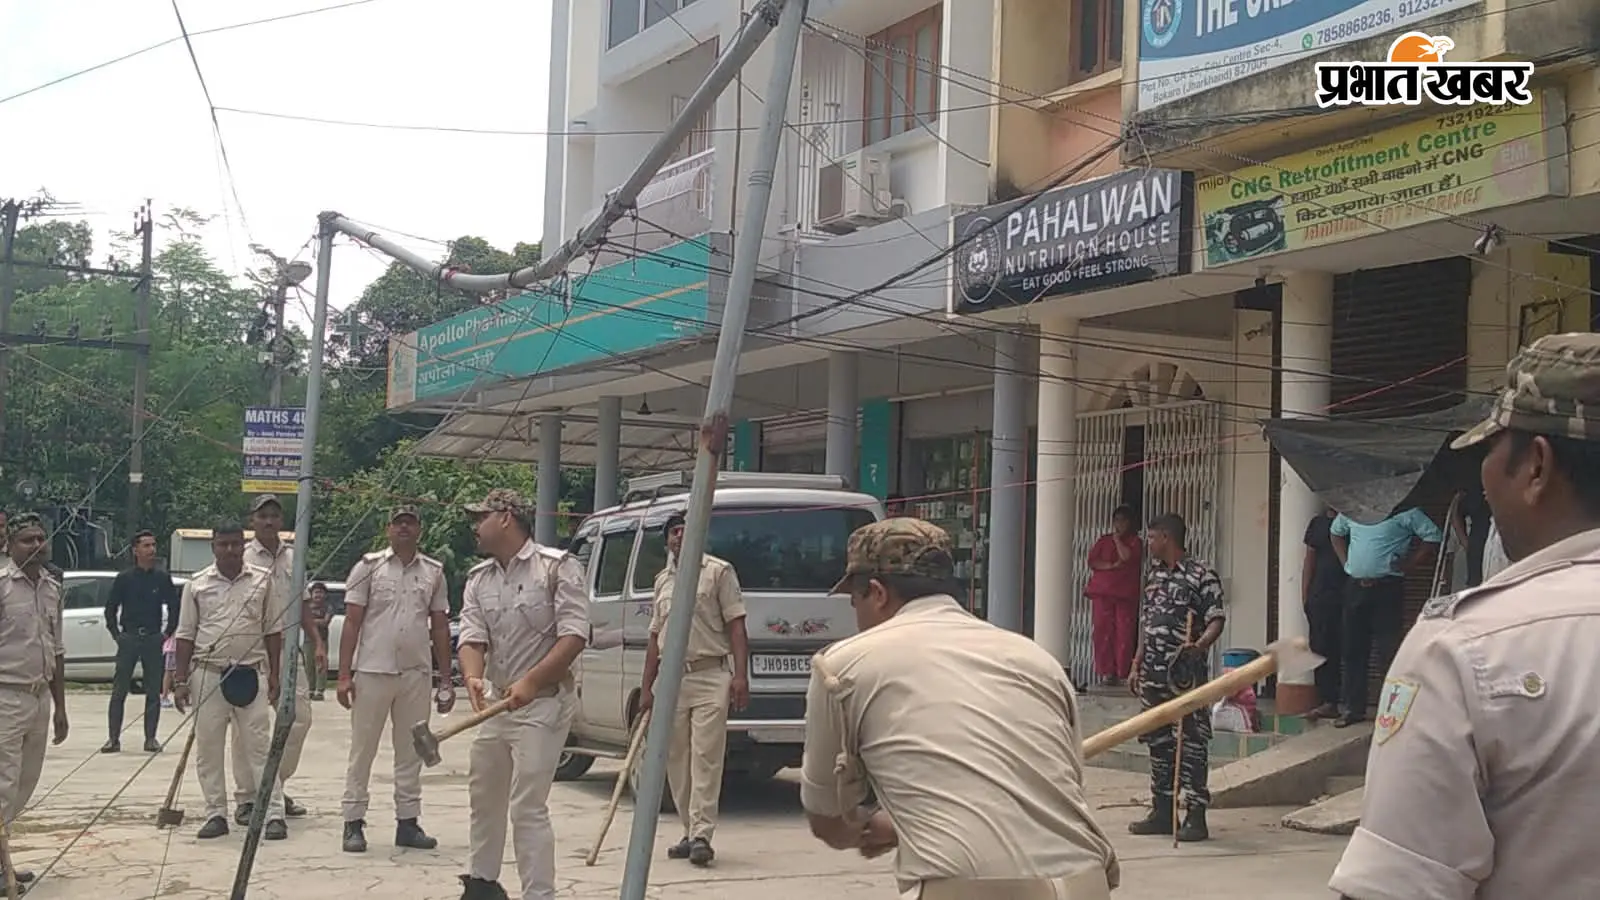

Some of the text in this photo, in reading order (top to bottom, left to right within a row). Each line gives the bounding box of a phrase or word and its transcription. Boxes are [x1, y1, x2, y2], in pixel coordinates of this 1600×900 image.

[1317, 8, 1394, 45] 7858868236,
[1436, 102, 1522, 130] 73219229
[1231, 120, 1497, 200] CNG Retrofitment Centre
[1443, 143, 1484, 166] CNG
[1006, 173, 1173, 250] PAHALWAN
[1006, 236, 1098, 276] NUTRITION
[1106, 221, 1171, 255] HOUSE
[1022, 254, 1149, 291] EAT GOOD FEEL STRONG
[245, 409, 289, 425] MATHS
[762, 656, 811, 671] JH09BC5
